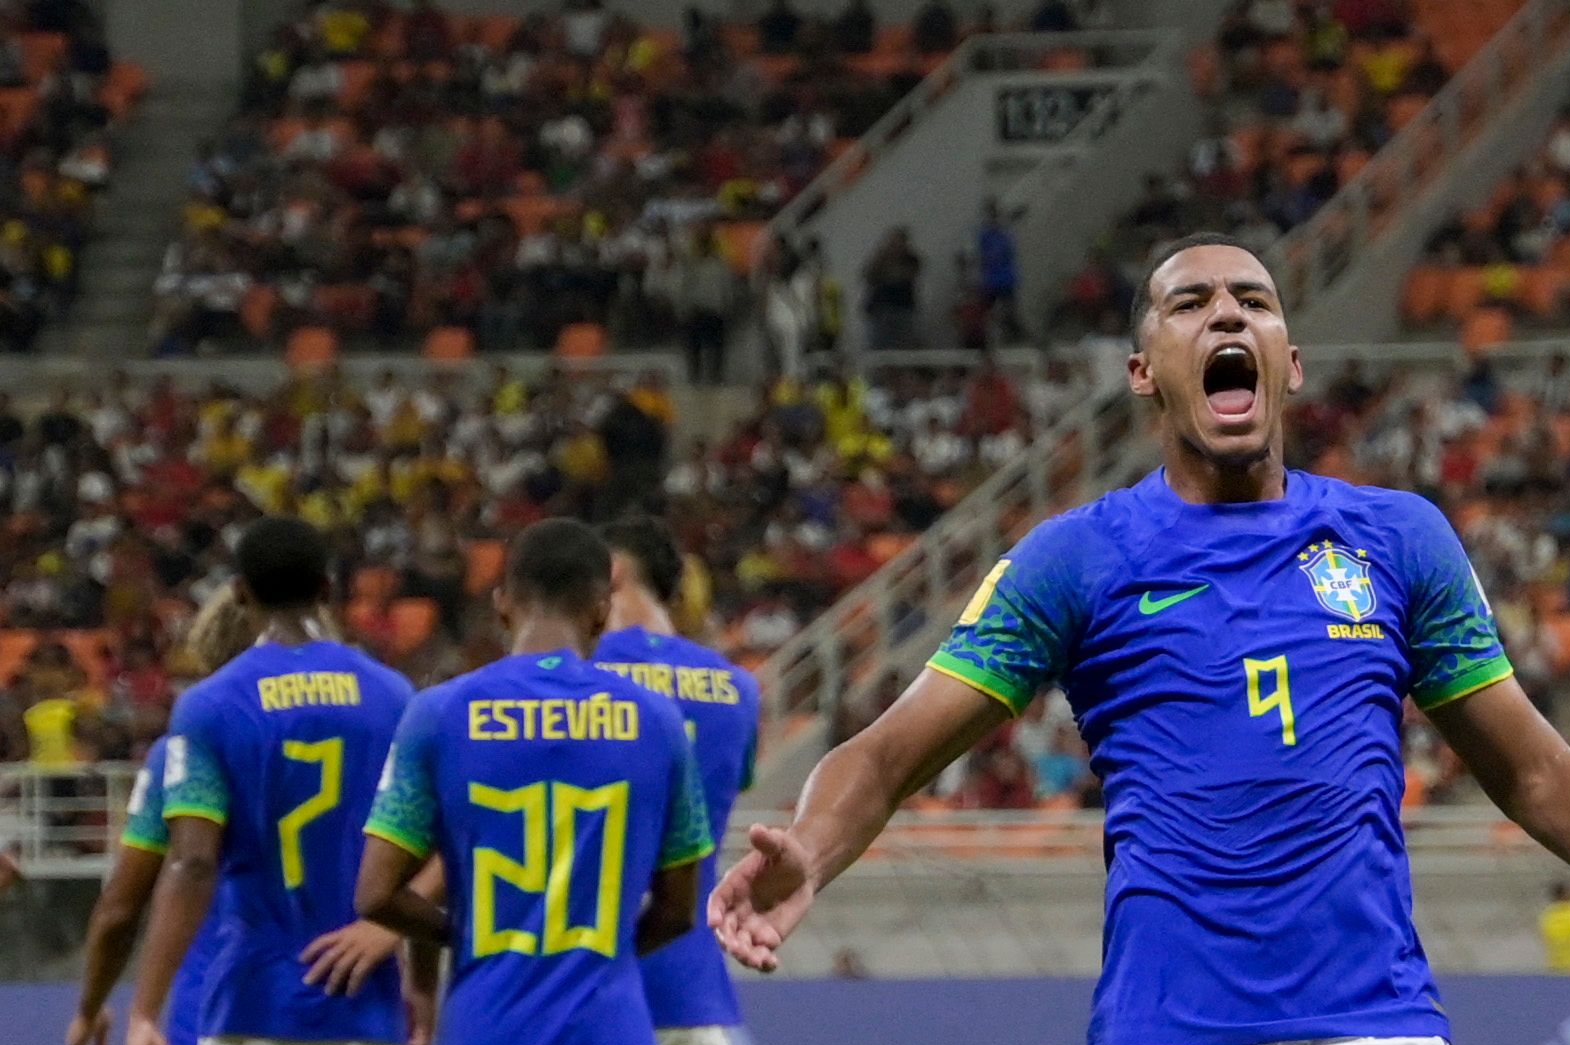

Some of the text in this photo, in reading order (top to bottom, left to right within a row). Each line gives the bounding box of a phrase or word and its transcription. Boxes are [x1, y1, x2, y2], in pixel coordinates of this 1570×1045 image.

[1330, 580, 1352, 590] CBF
[1327, 624, 1384, 639] BRASIL
[257, 671, 361, 712] RAYAN
[676, 666, 740, 705] REIS
[1243, 654, 1296, 745] 9
[278, 736, 343, 889] 7
[468, 780, 630, 959] 20
